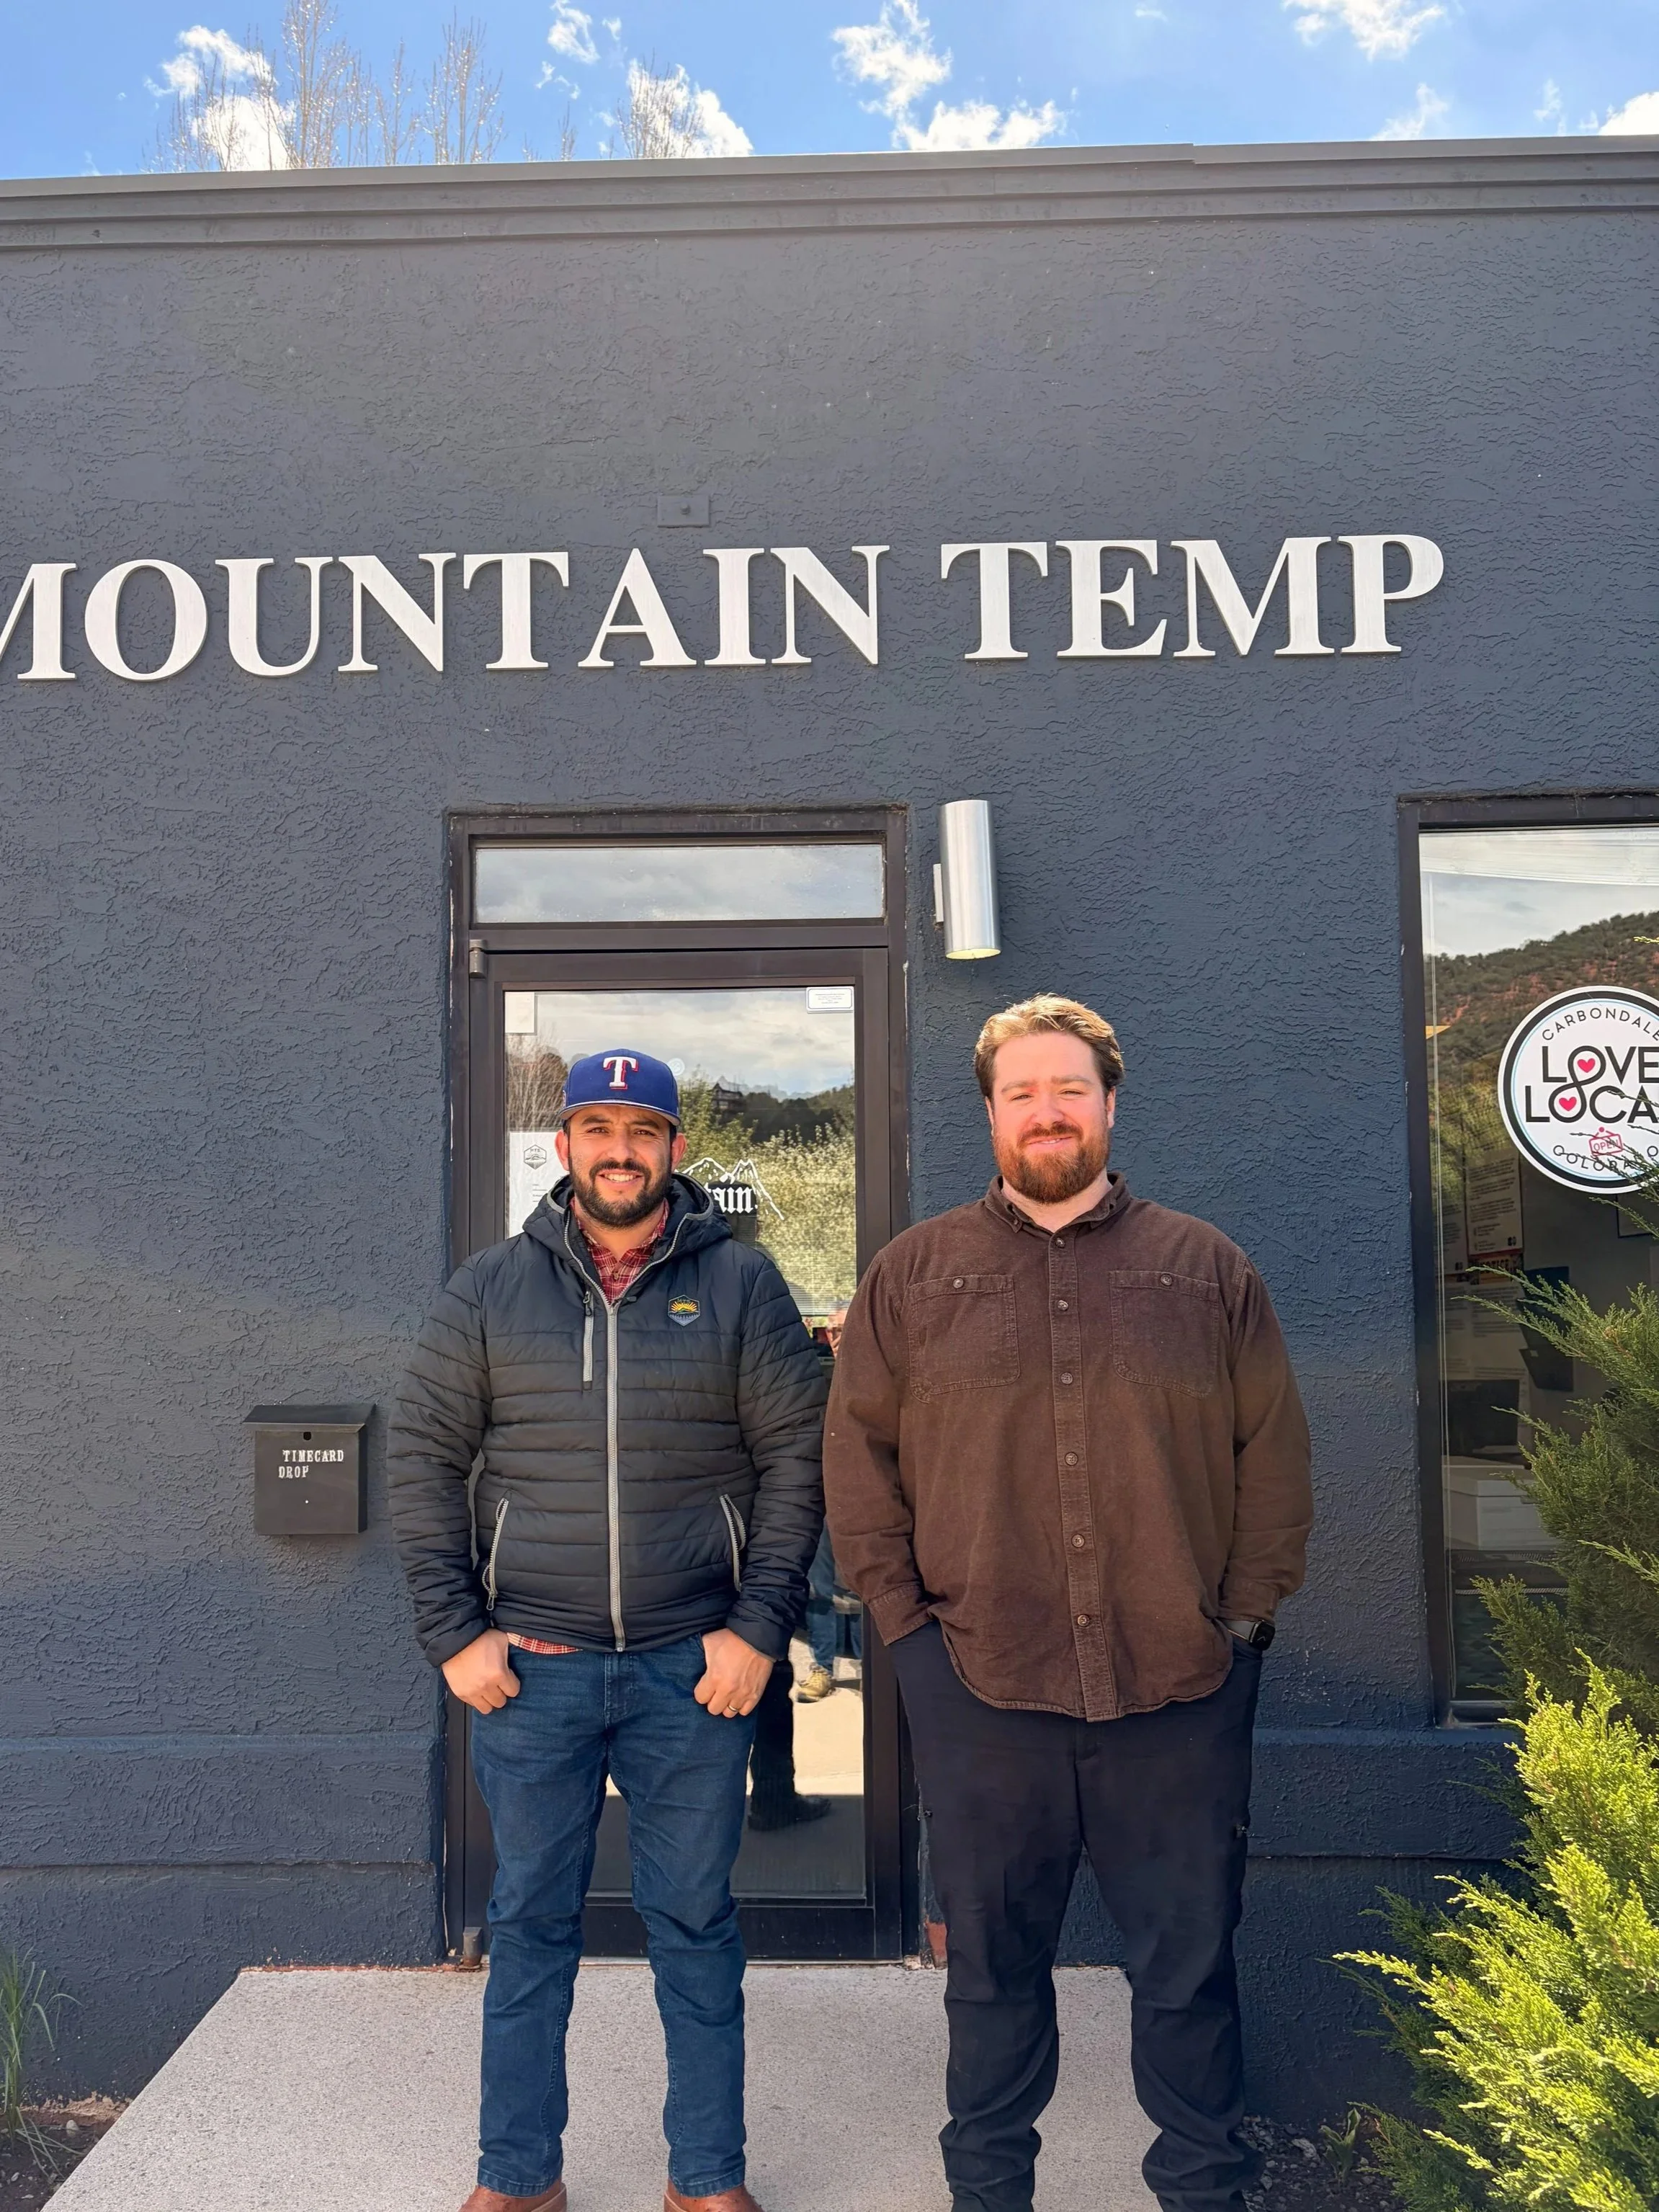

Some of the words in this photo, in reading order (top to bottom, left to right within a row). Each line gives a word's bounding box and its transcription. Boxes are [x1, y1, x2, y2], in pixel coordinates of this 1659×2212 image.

[941, 534, 1444, 660] TEMP
[1542, 1008, 1659, 1040] CARBONDALE
[603, 1056, 639, 1090] T
[1542, 1045, 1659, 1084] LOVE
[1553, 1145, 1658, 1172] COLORAO
[1593, 1140, 1619, 1151] OPEN
[282, 1450, 344, 1463] TIMECARD
[278, 1465, 309, 1479] DROP
